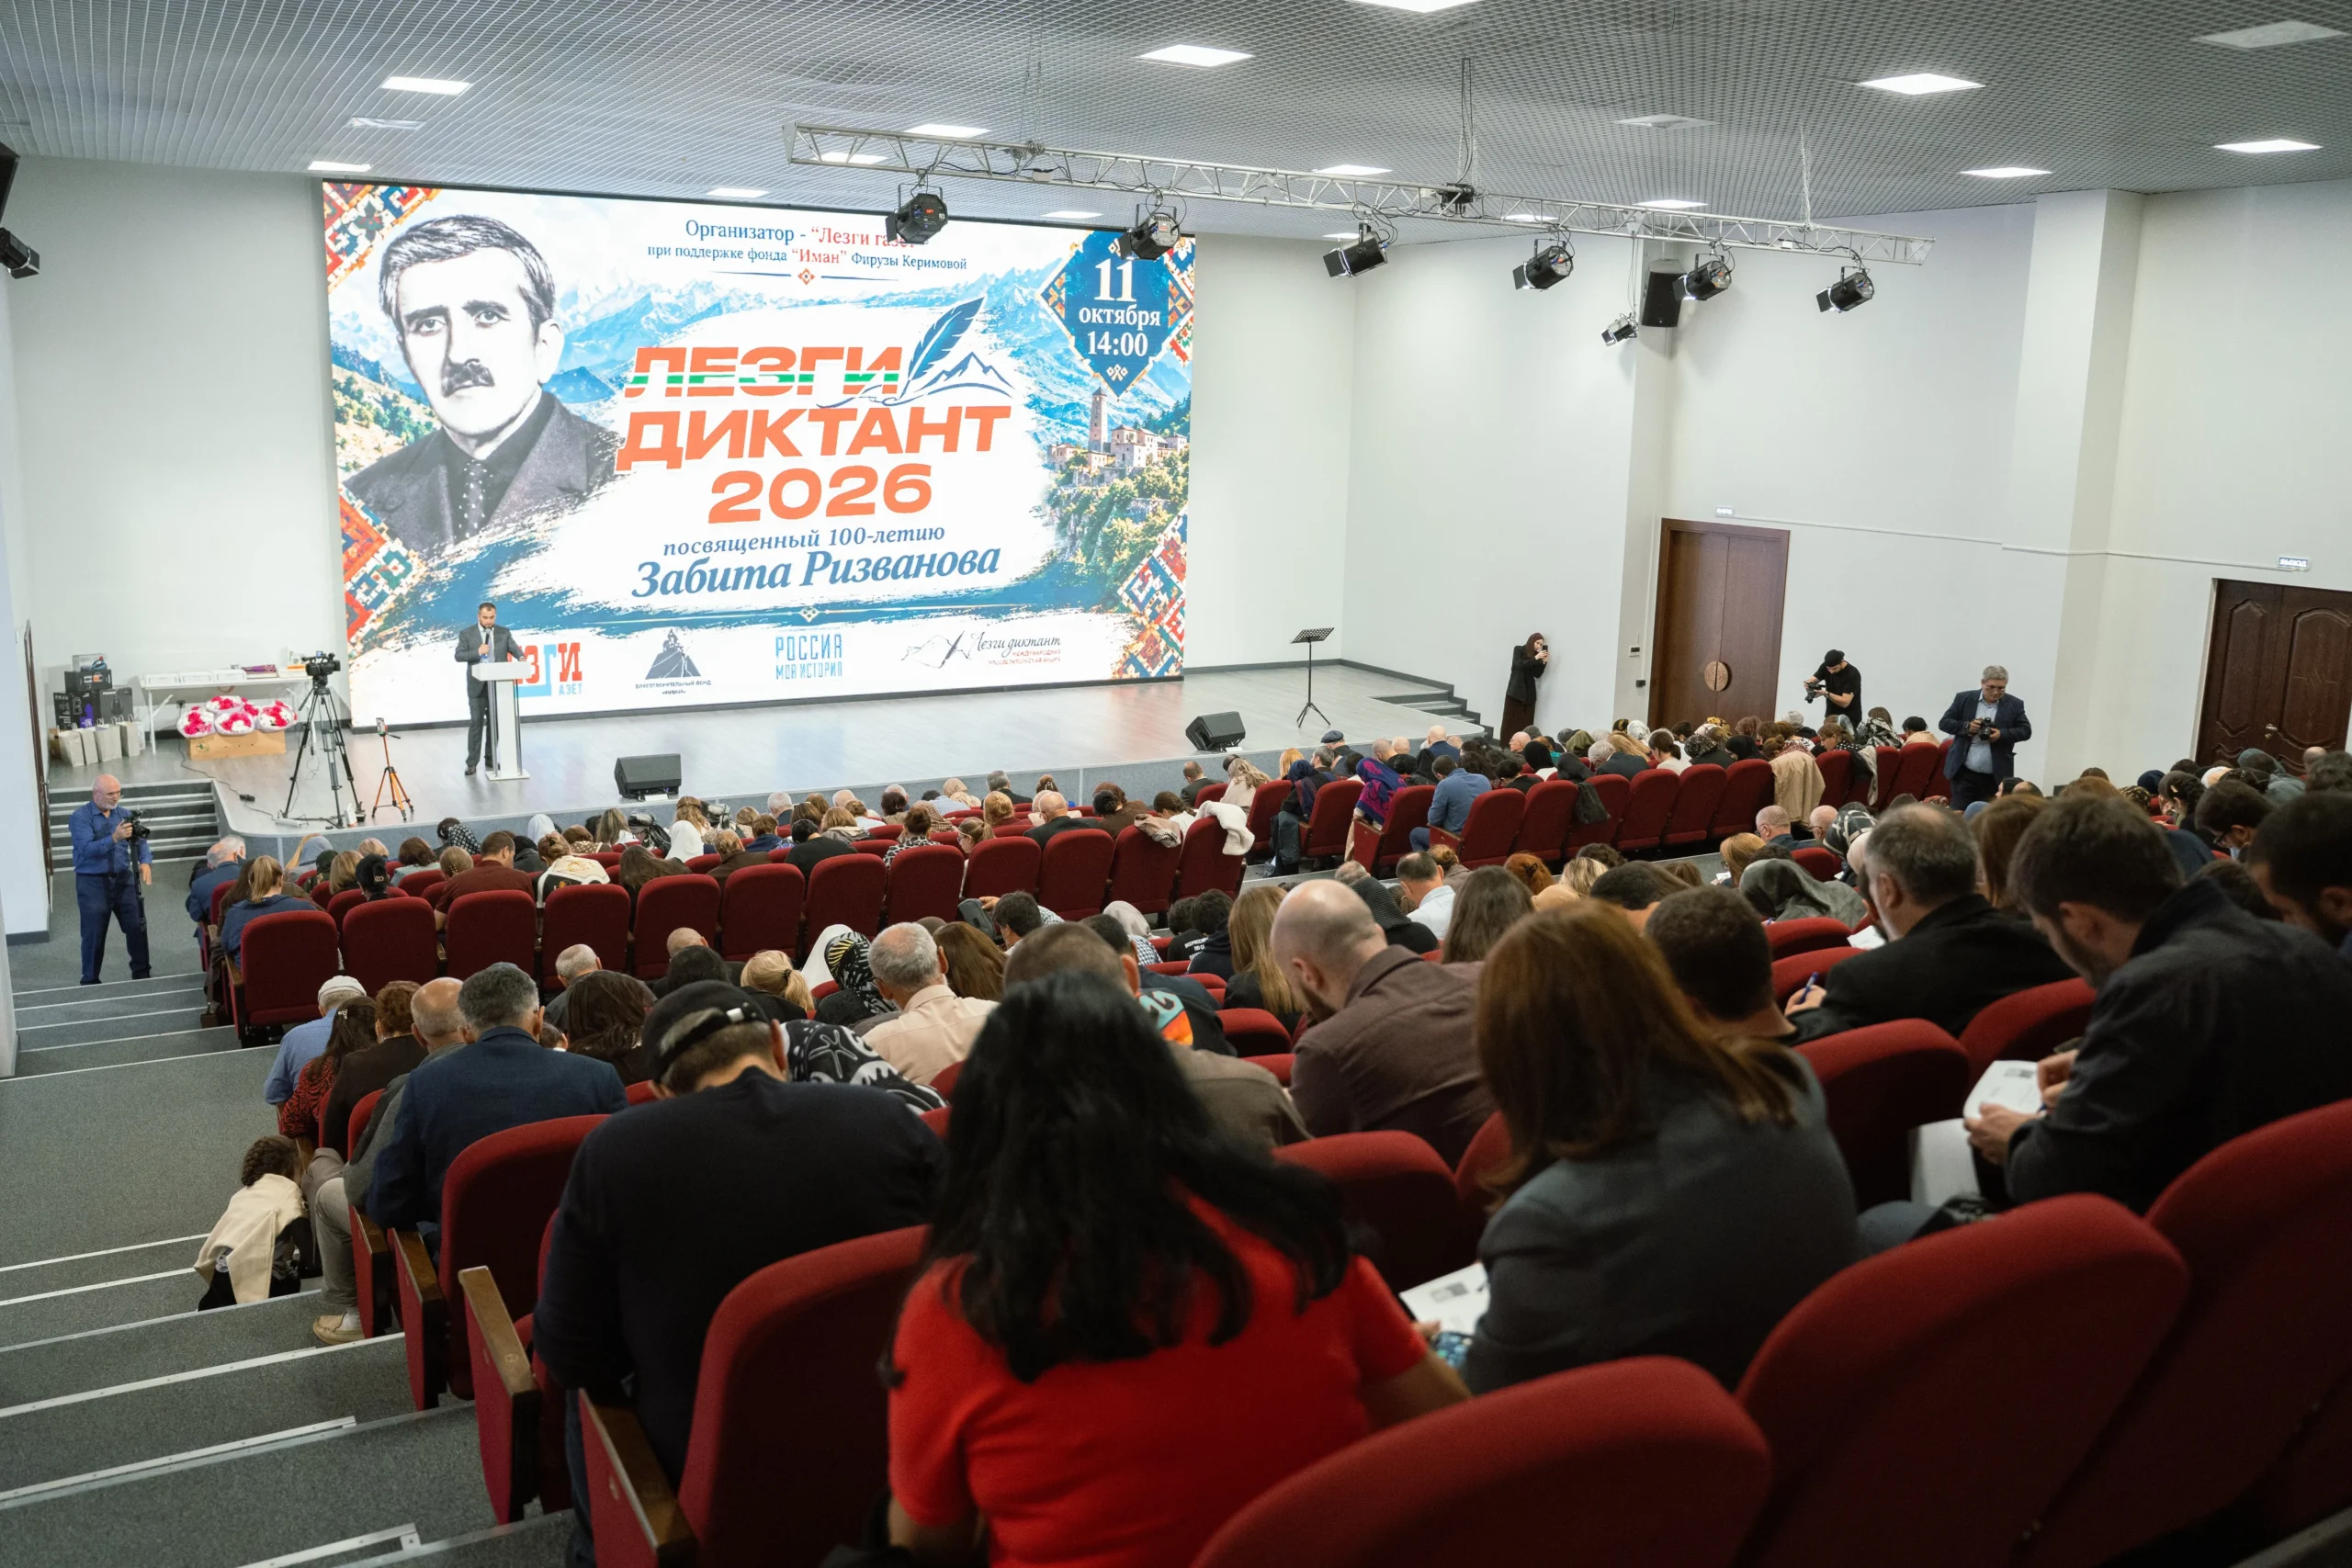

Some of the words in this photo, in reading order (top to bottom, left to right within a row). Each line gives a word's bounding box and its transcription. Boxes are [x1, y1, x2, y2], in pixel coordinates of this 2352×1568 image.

[685, 220, 795, 245] Организатор
[875, 233, 914, 248] газе
[648, 246, 672, 258] при
[675, 247, 743, 261] поддержке
[748, 248, 787, 263] фонда
[852, 252, 899, 268] Фирузы
[902, 254, 967, 270] Керимовой
[1094, 258, 1136, 302] 11
[1079, 304, 1161, 331] октября
[1087, 331, 1148, 356] 14:00
[625, 346, 902, 398] ЛЕЗГИ
[616, 405, 1012, 471] ДИКТАНТ
[708, 463, 932, 524] 2026
[663, 529, 820, 557] посвященный
[828, 525, 945, 547] 100-летию
[631, 556, 791, 598] Забита
[799, 547, 1001, 586] Ризванова
[775, 634, 842, 660] РОССИЯ
[1001, 637, 1061, 658] диктант
[775, 664, 797, 680] МОЯ
[799, 661, 842, 679] ИСТОРИЯ
